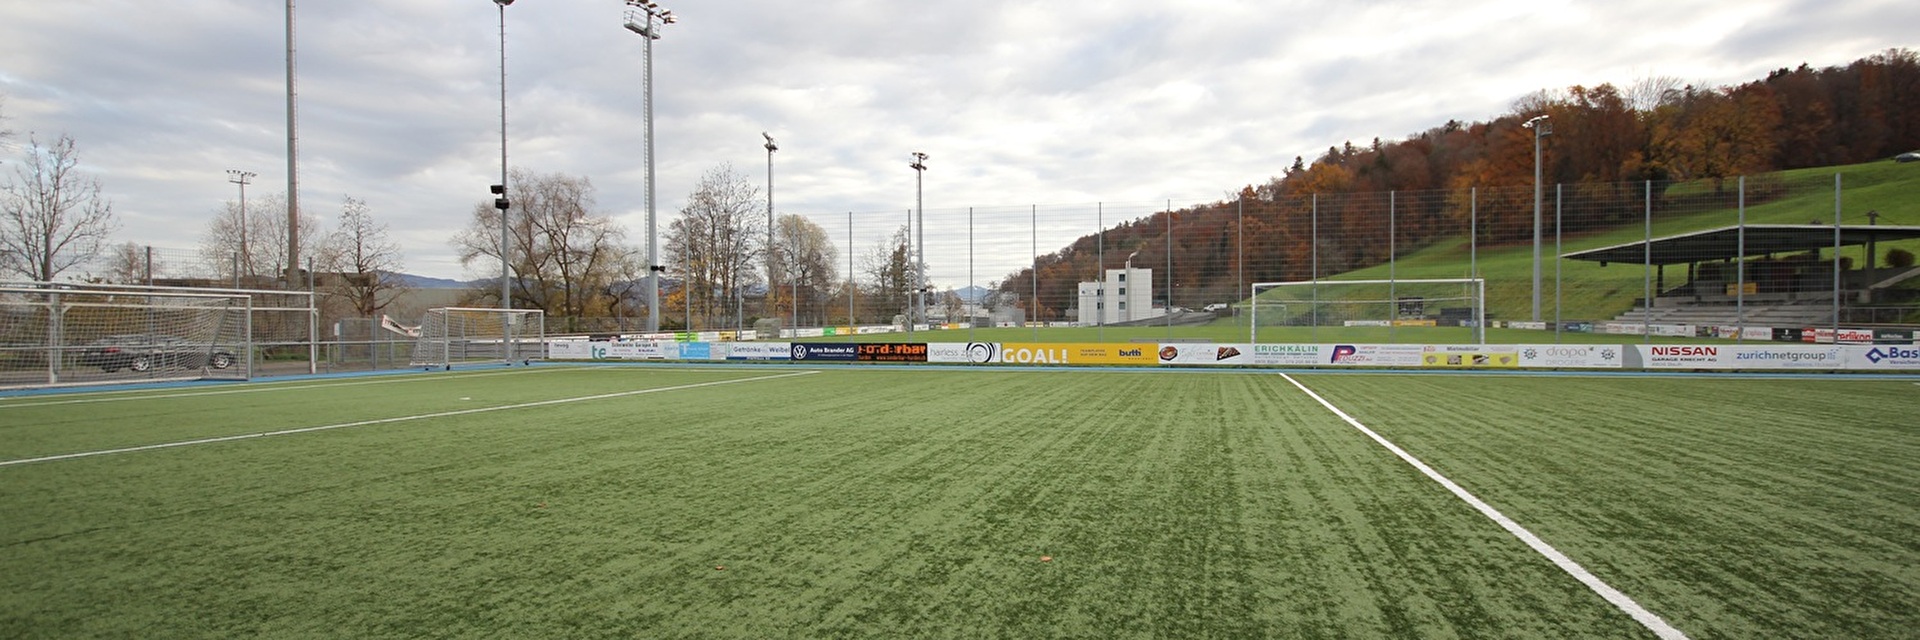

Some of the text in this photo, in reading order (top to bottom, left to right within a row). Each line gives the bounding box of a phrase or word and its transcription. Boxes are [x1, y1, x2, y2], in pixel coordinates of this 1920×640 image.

[1002, 348, 1069, 364] GOAL!
[1119, 348, 1142, 357] butti
[1545, 346, 1587, 358] dropa
[1651, 347, 1717, 356] NISSAN
[1736, 350, 1826, 362] zurichnetgroup
